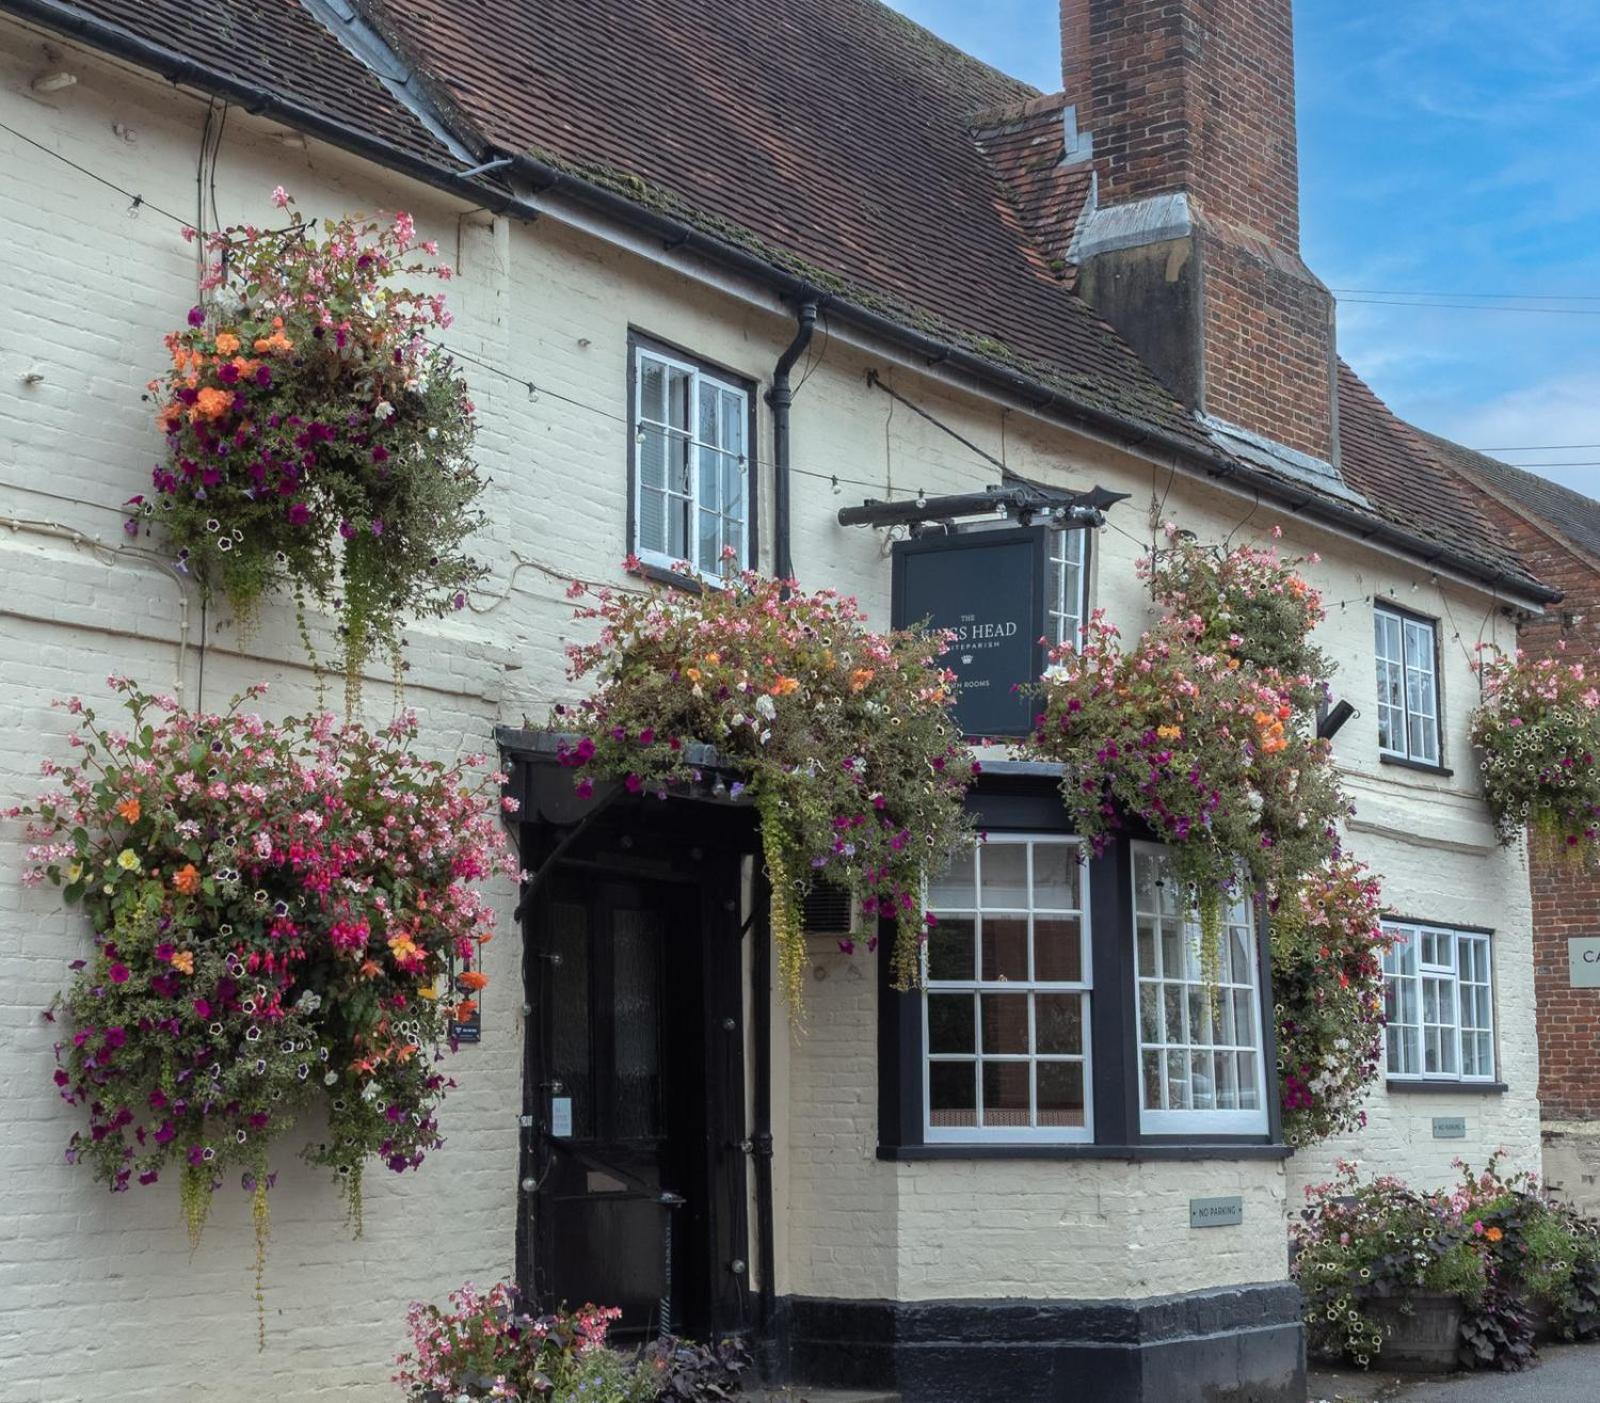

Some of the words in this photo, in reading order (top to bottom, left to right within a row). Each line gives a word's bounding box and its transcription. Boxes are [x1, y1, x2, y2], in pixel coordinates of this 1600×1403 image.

[961, 614, 975, 622] THE
[921, 626, 967, 642] KGS
[972, 622, 1017, 639] HEAD
[951, 641, 1000, 651] ITEPARISH
[964, 680, 990, 688] ROOMS
[1199, 1208, 1210, 1217] NO
[1210, 1206, 1236, 1217] PARKING
